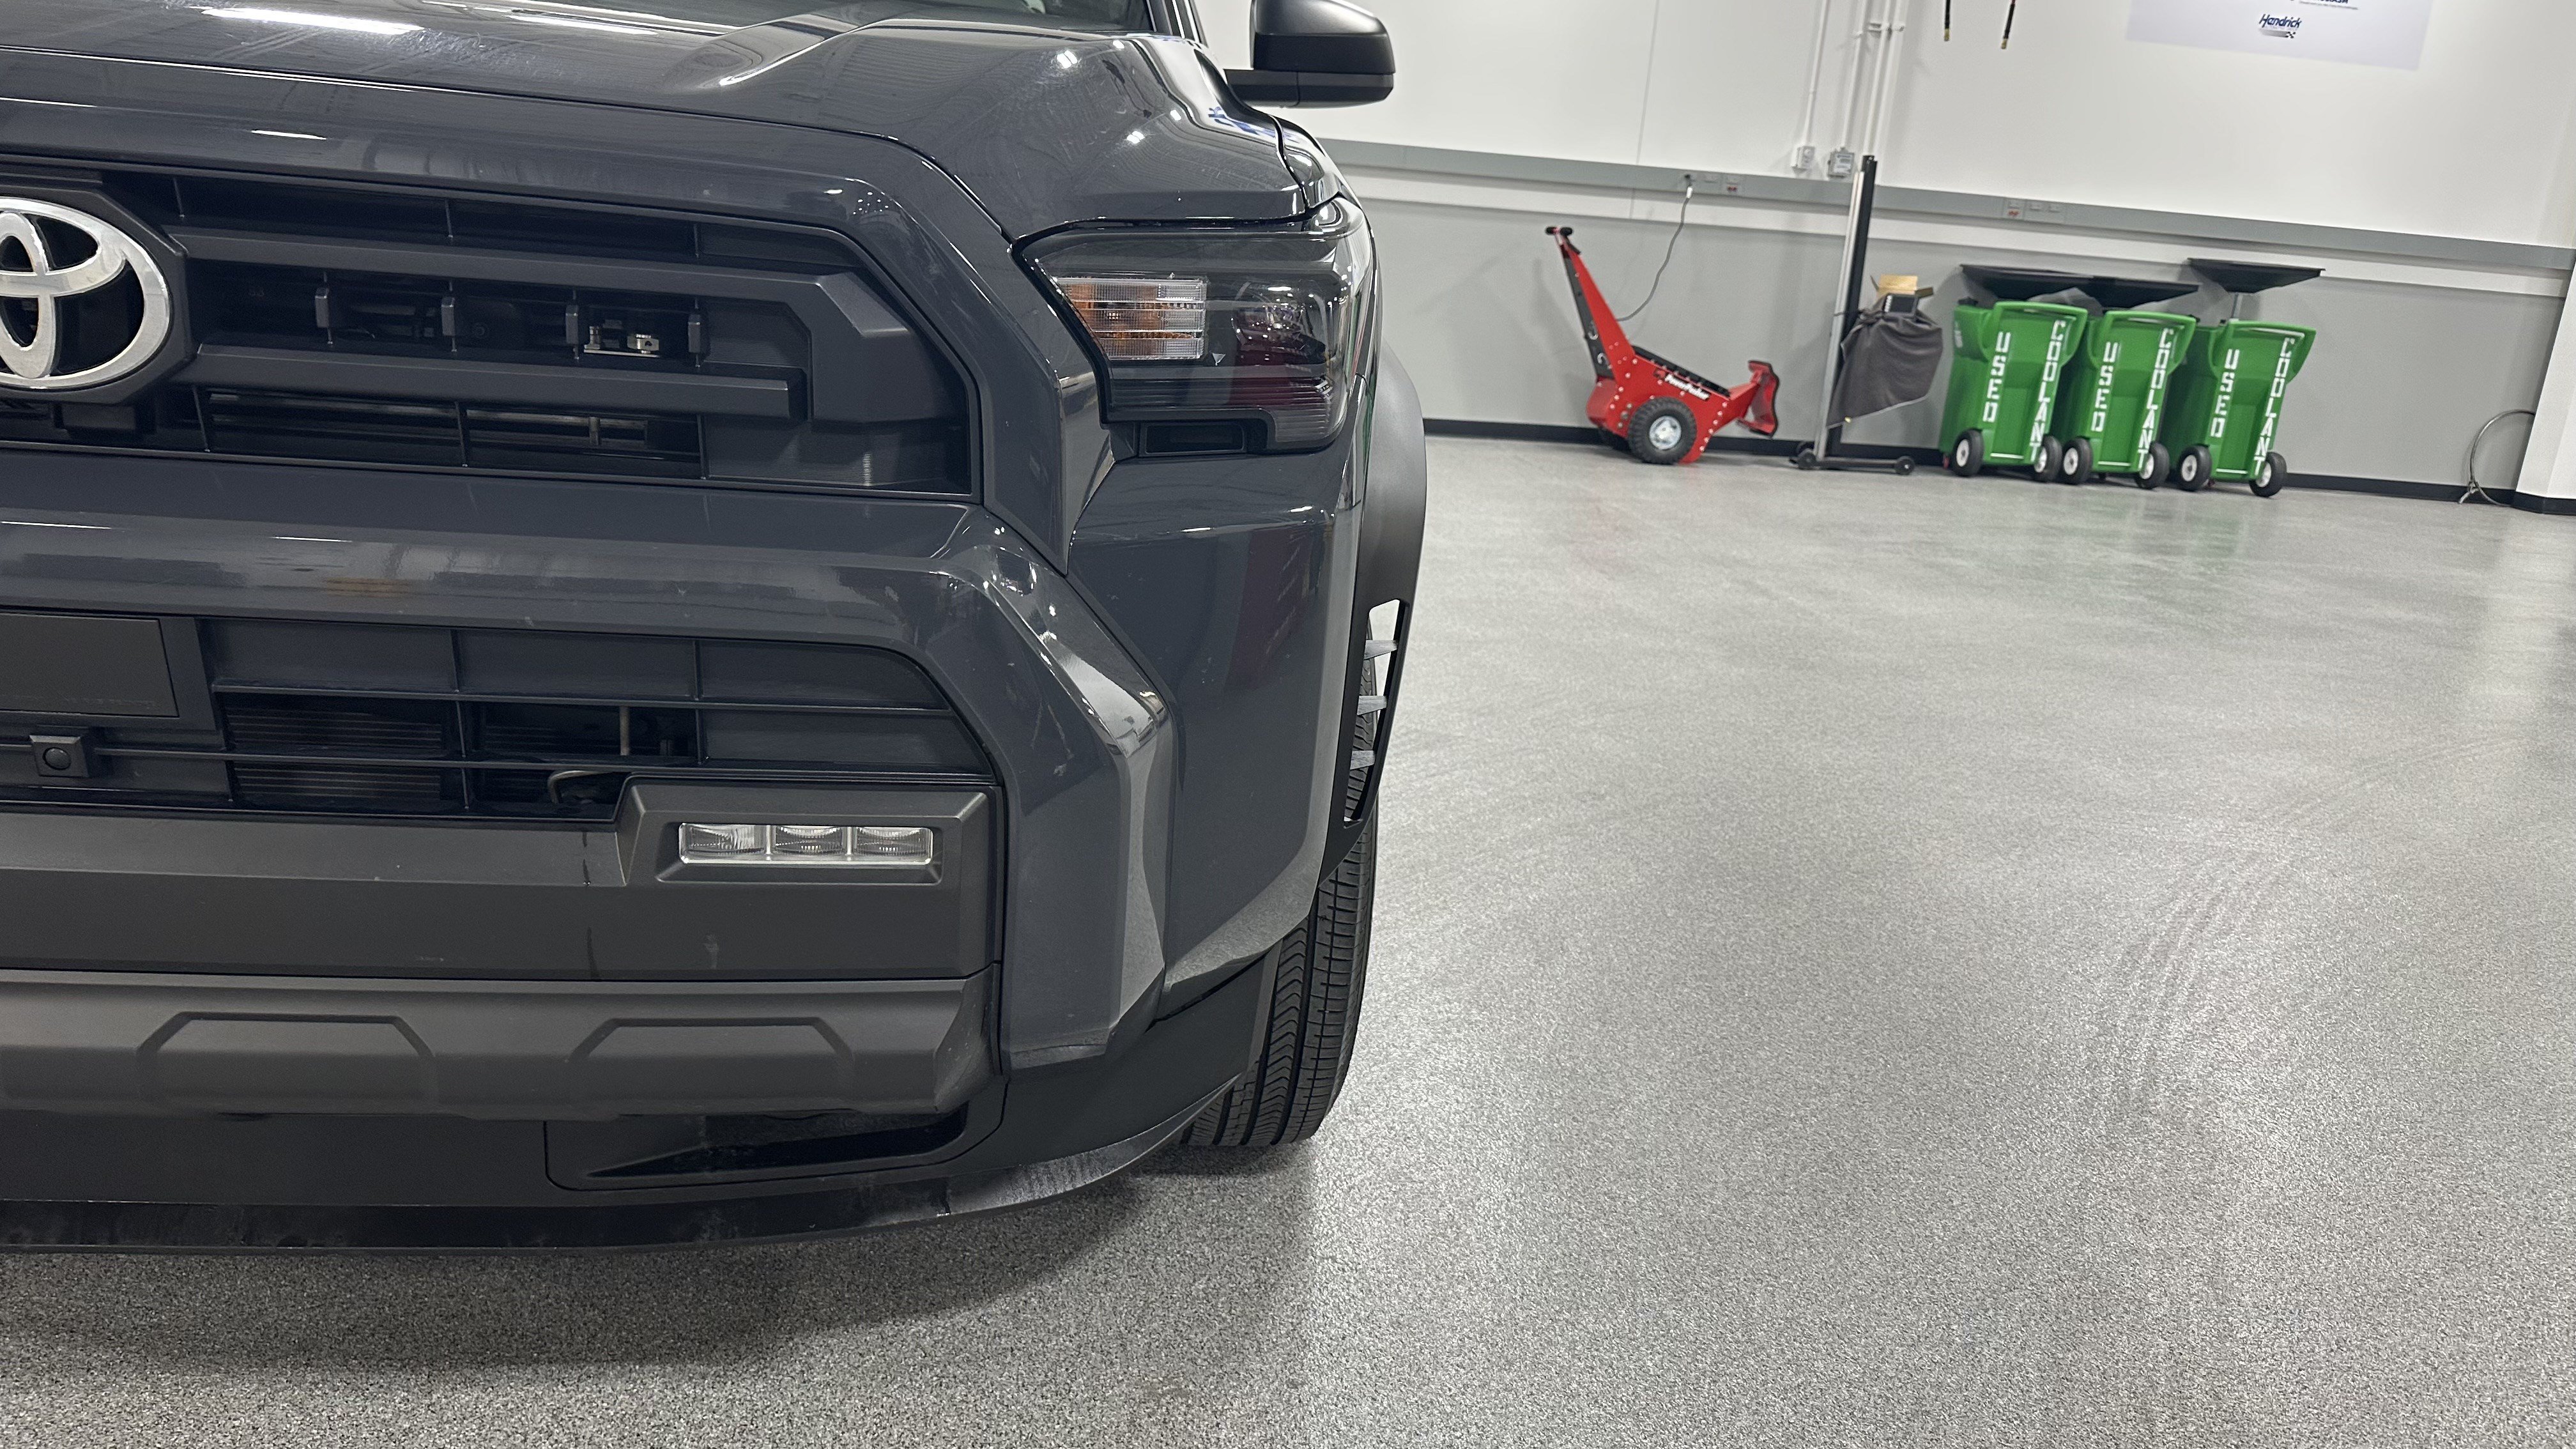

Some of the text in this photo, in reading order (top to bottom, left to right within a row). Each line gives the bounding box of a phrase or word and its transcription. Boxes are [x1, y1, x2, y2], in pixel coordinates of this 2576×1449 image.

[2259, 13, 2302, 28] Hendrick
[1982, 331, 2011, 422] USED
[2030, 320, 2066, 463] COOLANT
[2091, 342, 2119, 432] USED
[2138, 328, 2174, 471] COOLANT
[2211, 348, 2240, 438] USED
[2253, 337, 2296, 475] COOLANT
